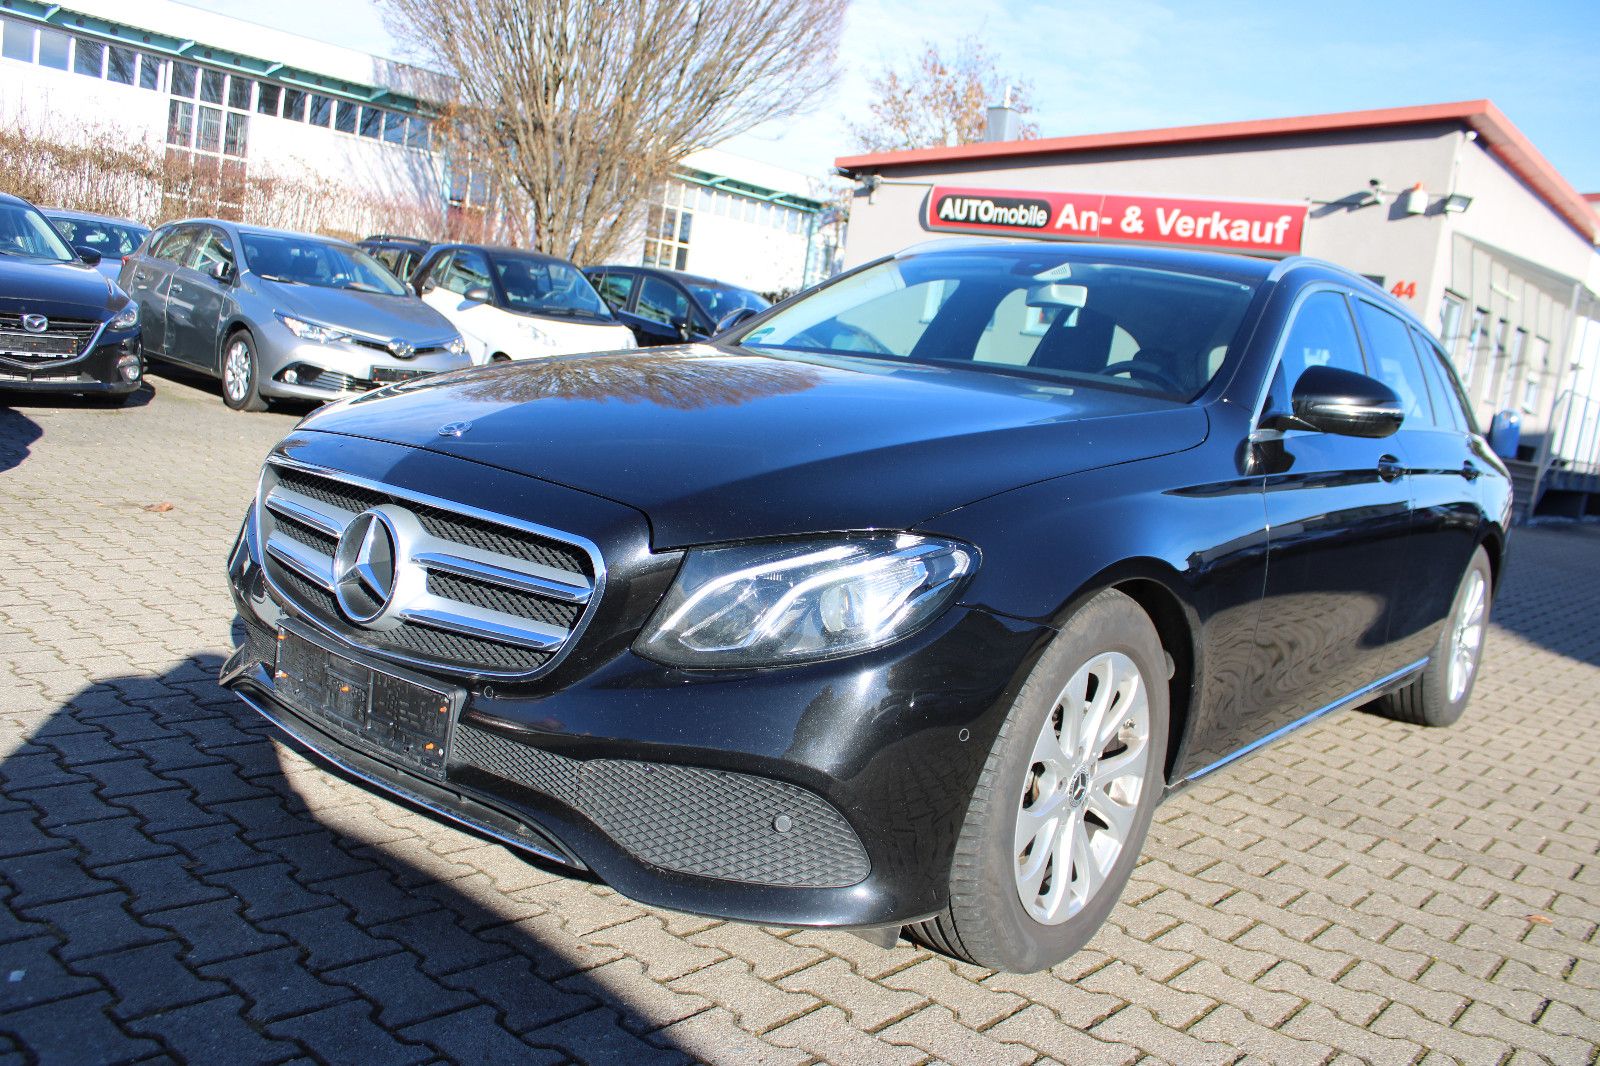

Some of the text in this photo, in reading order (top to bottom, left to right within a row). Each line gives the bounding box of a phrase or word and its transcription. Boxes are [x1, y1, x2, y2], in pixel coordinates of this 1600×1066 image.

[938, 198, 1292, 245] AUTOmobile An- & Verkauf
[1391, 280, 1417, 299] 44
